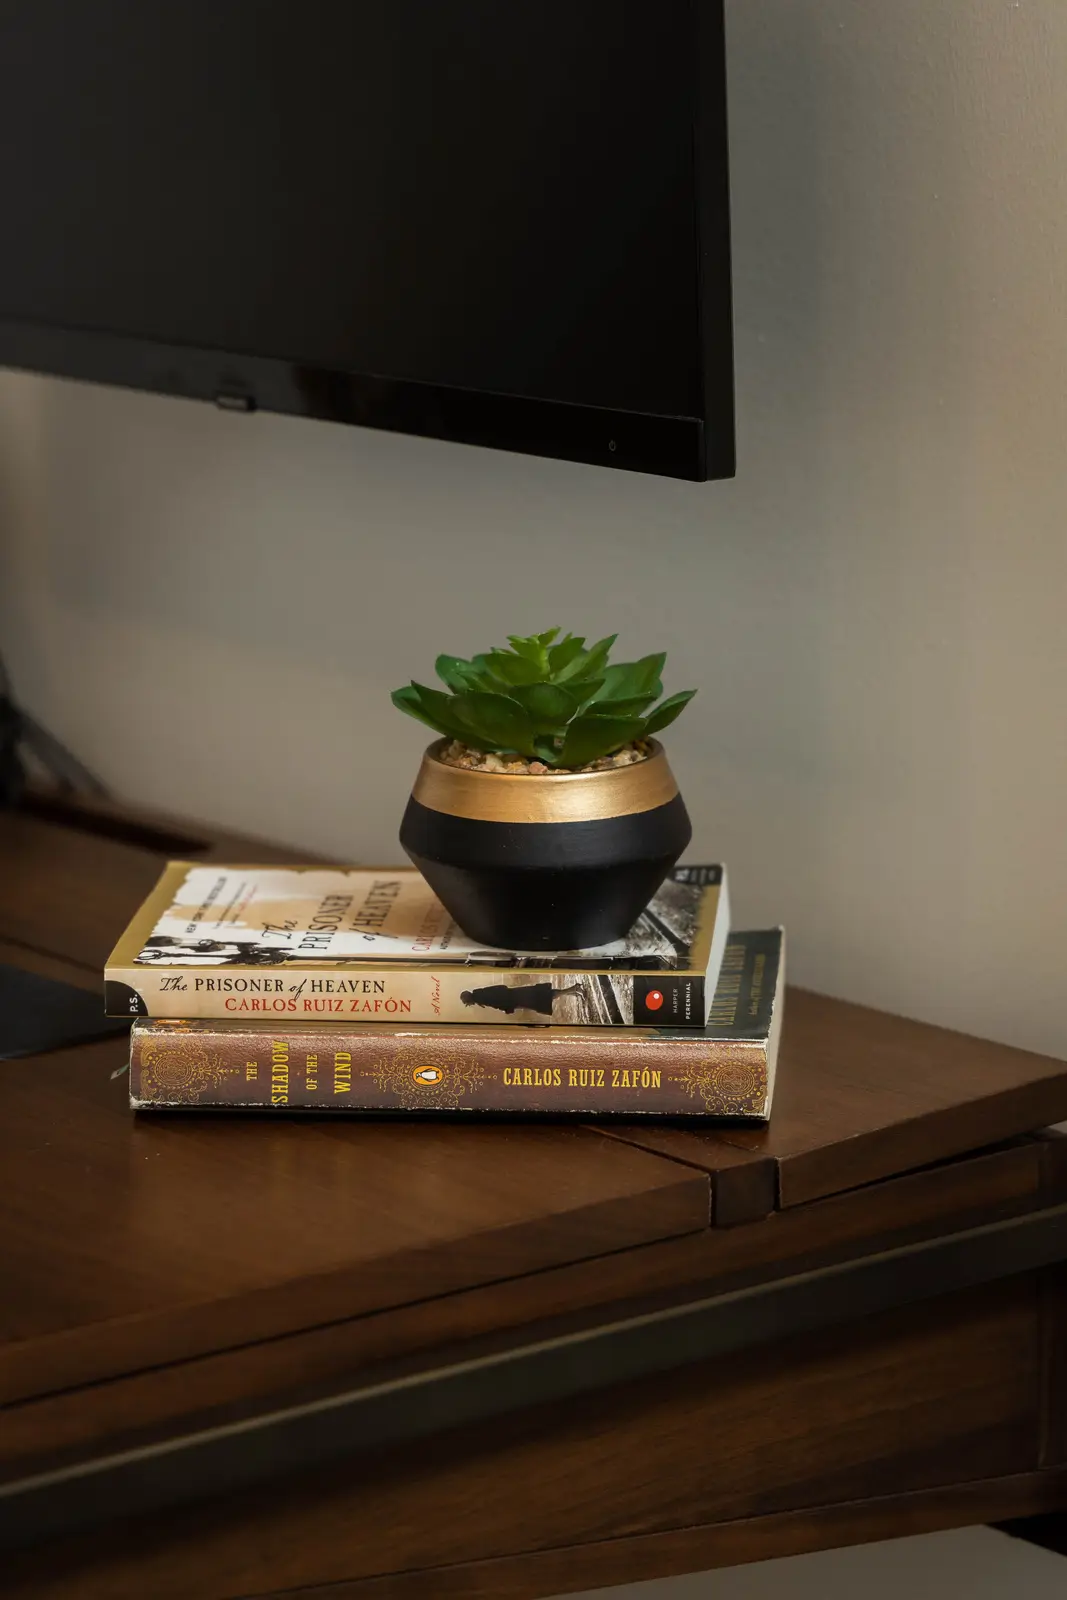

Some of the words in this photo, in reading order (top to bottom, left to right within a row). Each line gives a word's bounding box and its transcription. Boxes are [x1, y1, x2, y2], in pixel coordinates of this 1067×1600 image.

[353, 880, 402, 927] HEAVEN
[261, 920, 298, 940] The
[299, 893, 355, 951] PRISONER
[349, 926, 399, 942] of
[160, 975, 188, 991] The
[195, 978, 283, 992] PRISONER
[288, 978, 308, 1000] of
[311, 979, 386, 993] HEAVEN
[431, 975, 441, 1003] Novel
[129, 994, 139, 1012] P.S.
[225, 998, 297, 1012] CARLOS
[303, 999, 344, 1012] RUIZ
[350, 996, 412, 1013] ZAFÓN
[246, 1061, 258, 1081] THE
[271, 1039, 290, 1104] SHADOW
[306, 1054, 318, 1073] THE
[334, 1051, 352, 1094] WIND
[305, 1077, 318, 1090] OF
[503, 1067, 562, 1086] CARLOS
[568, 1069, 605, 1087] RUIZ
[611, 1066, 662, 1088] ZAFÓN
